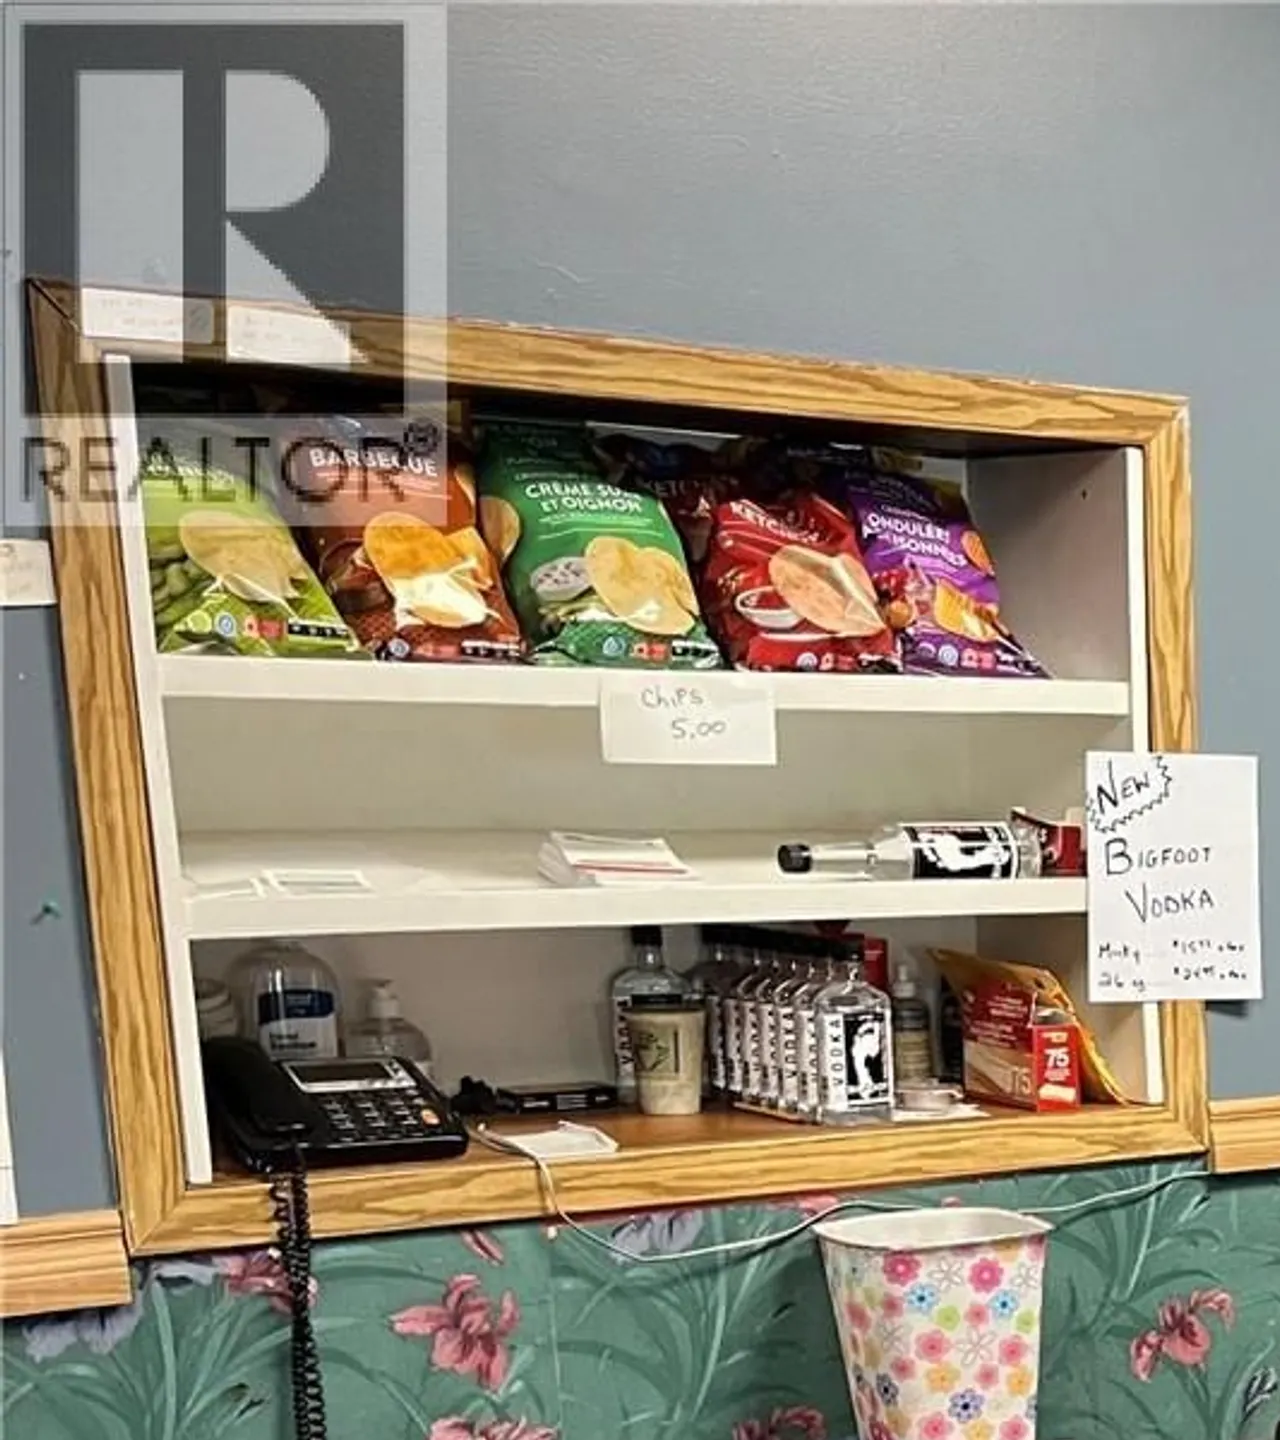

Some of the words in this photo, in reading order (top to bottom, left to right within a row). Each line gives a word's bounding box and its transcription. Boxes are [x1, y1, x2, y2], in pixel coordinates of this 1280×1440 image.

[671, 717, 727, 740] 5.00
[1105, 837, 1211, 877] BIGFOOT
[1125, 882, 1215, 923] VODKA
[829, 1018, 844, 1087] VODKA
[1045, 1047, 1071, 1068] 75
